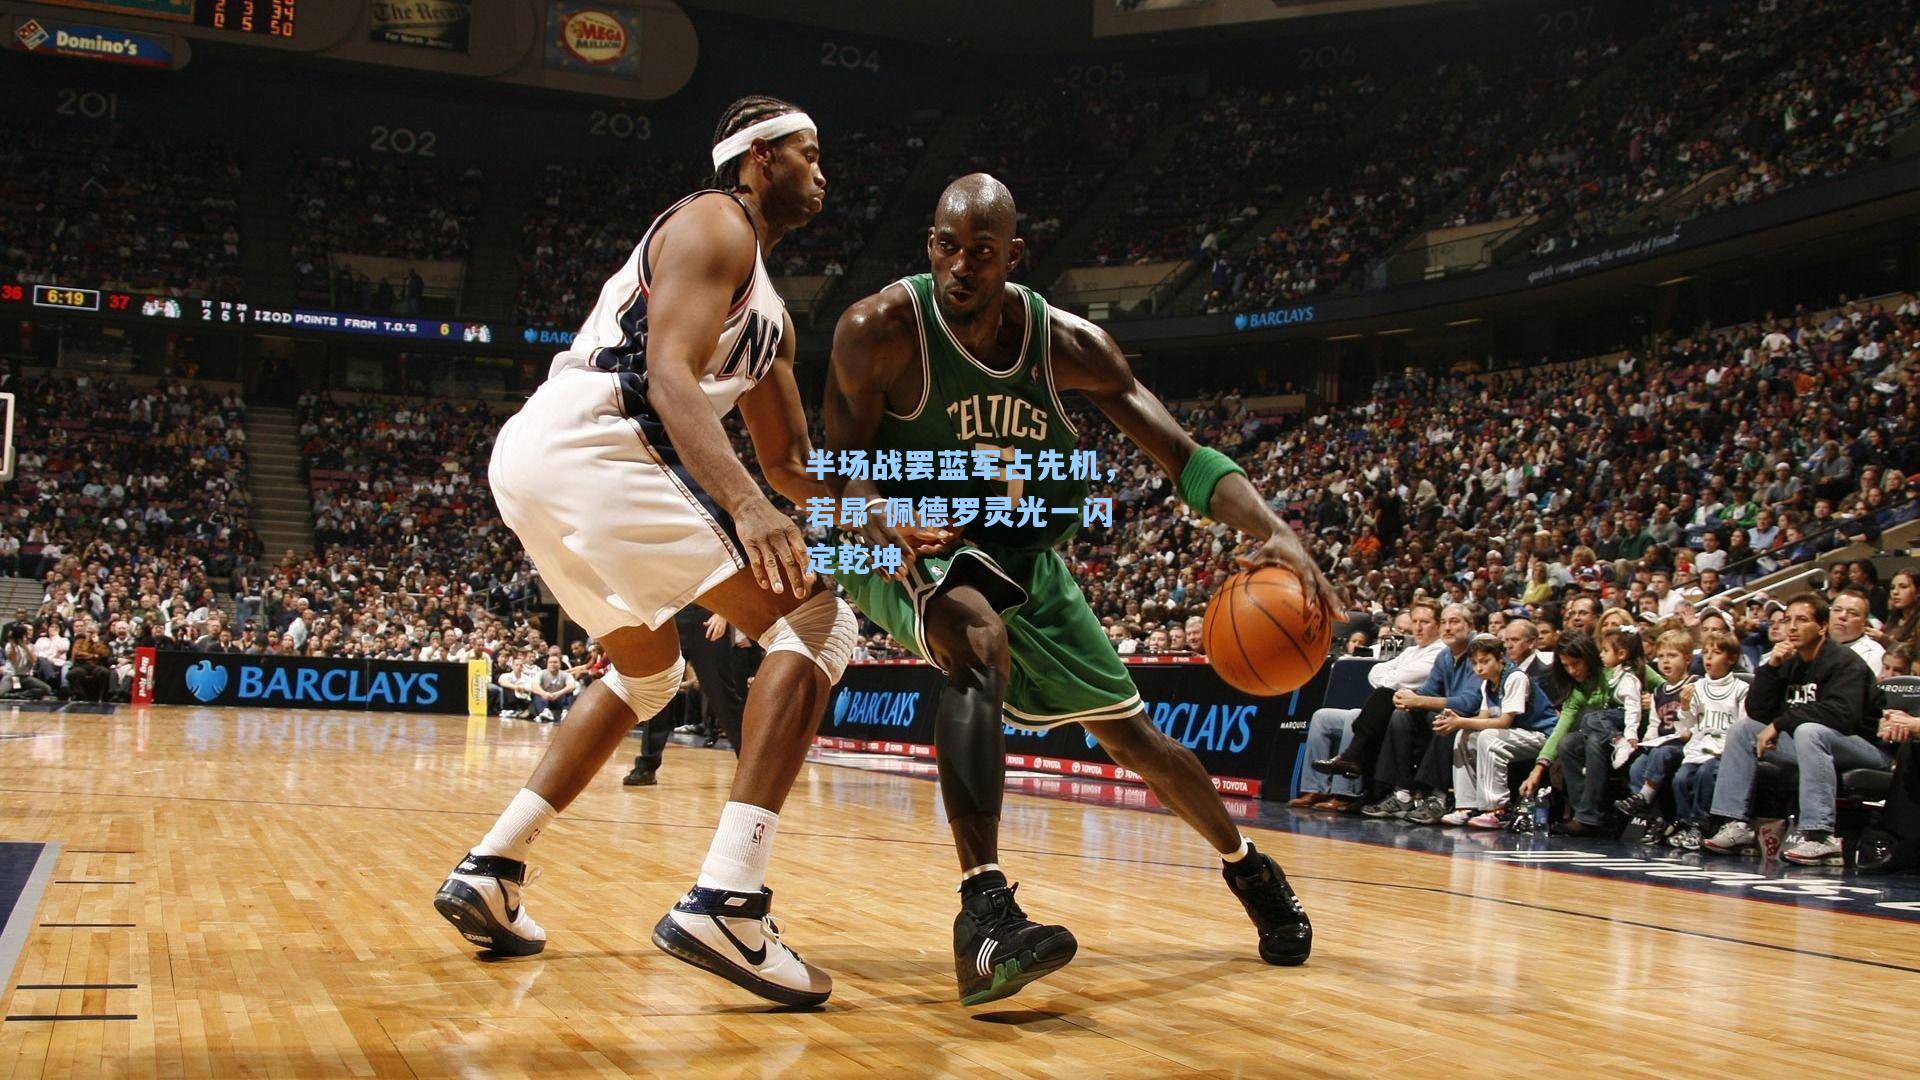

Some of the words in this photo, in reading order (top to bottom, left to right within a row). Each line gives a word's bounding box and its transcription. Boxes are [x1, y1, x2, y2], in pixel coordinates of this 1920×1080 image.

[56, 30, 138, 56] Domino's
[821, 42, 881, 73] 204
[56, 88, 118, 120] 201
[590, 111, 651, 140] 203
[370, 126, 436, 157] 202
[47, 289, 85, 305] 6:19
[109, 294, 130, 309] 37
[202, 308, 211, 320] 2
[255, 310, 292, 323] IZOD
[295, 313, 338, 326] POINTS
[344, 318, 377, 330] FROM
[440, 323, 449, 336] 6
[1250, 306, 1313, 328] BARCLAYS
[238, 665, 439, 705] BARCLAYS
[846, 690, 920, 727] BARCLAYS
[1696, 708, 1734, 732] CLTICS
[1280, 721, 1307, 730] MARQUIS
[1081, 763, 1102, 775] TOYOTA
[1222, 780, 1249, 792] TOYOTA
